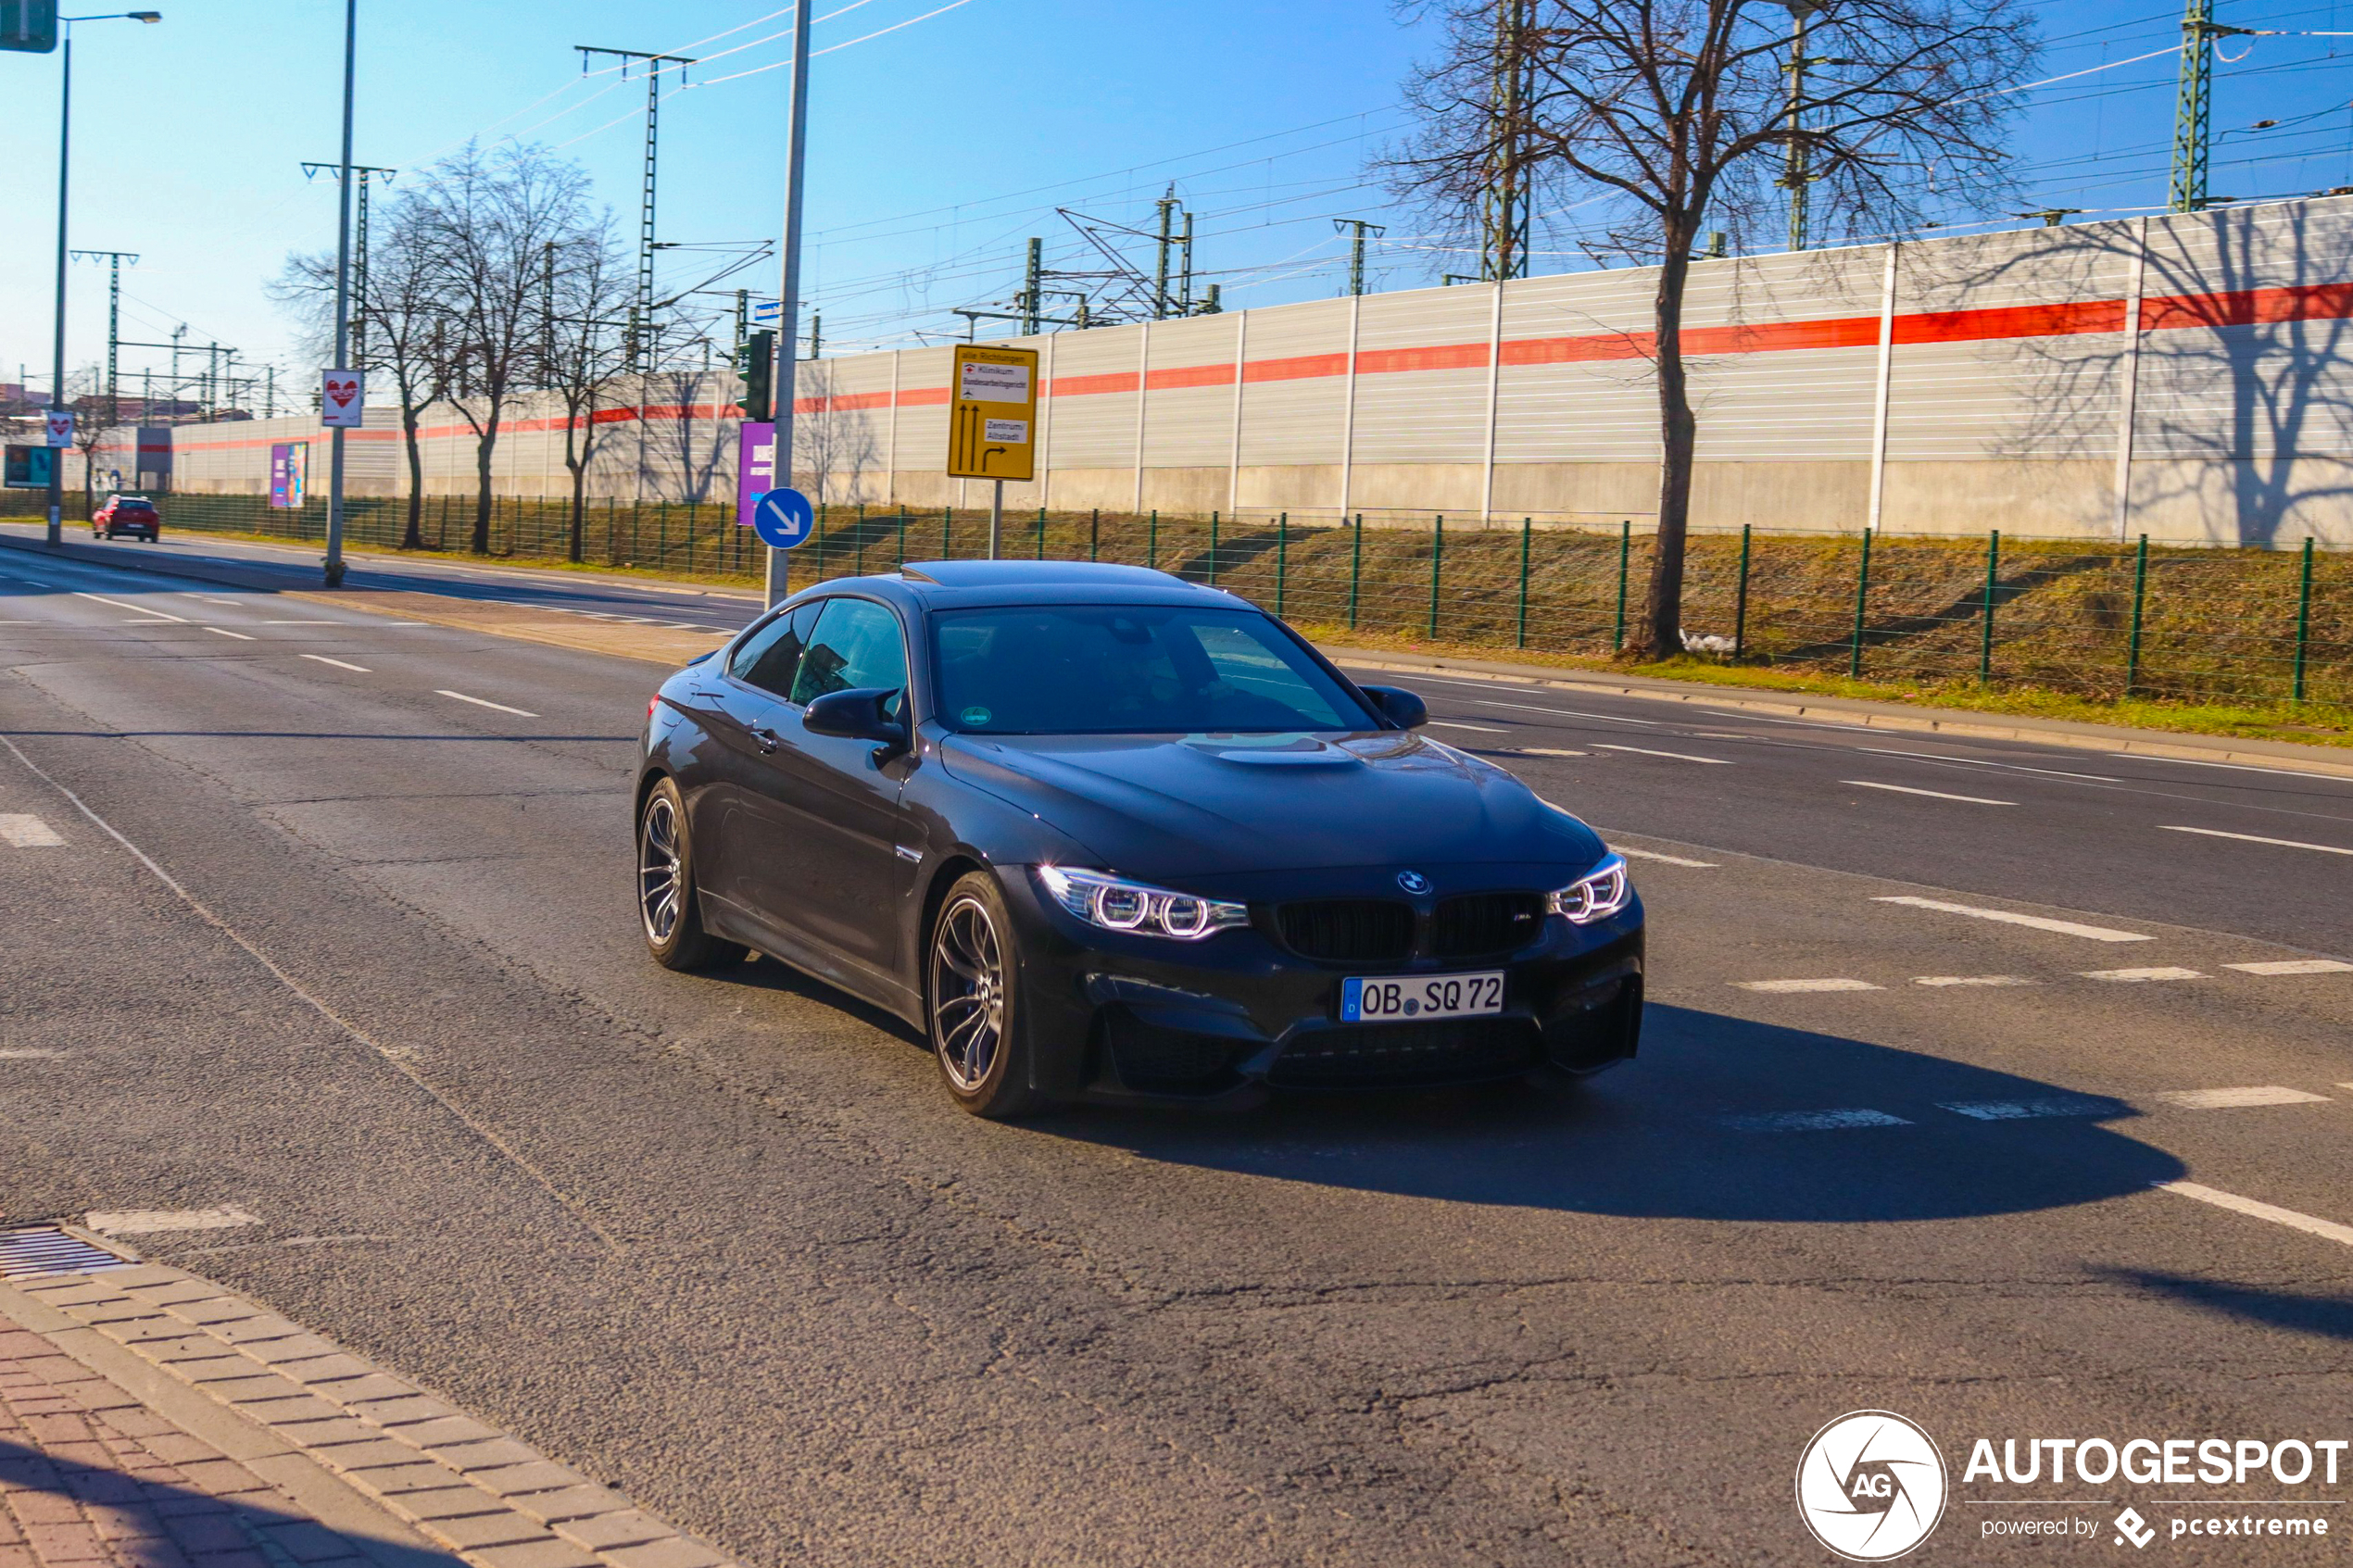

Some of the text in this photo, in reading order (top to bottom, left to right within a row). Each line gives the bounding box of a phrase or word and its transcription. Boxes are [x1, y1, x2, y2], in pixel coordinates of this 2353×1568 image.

[980, 352, 1025, 364] Richtungen
[978, 365, 1014, 375] Klinikum
[987, 432, 1019, 441] Altstadt
[1363, 984, 1402, 1015] OB
[1348, 1004, 1356, 1013] D
